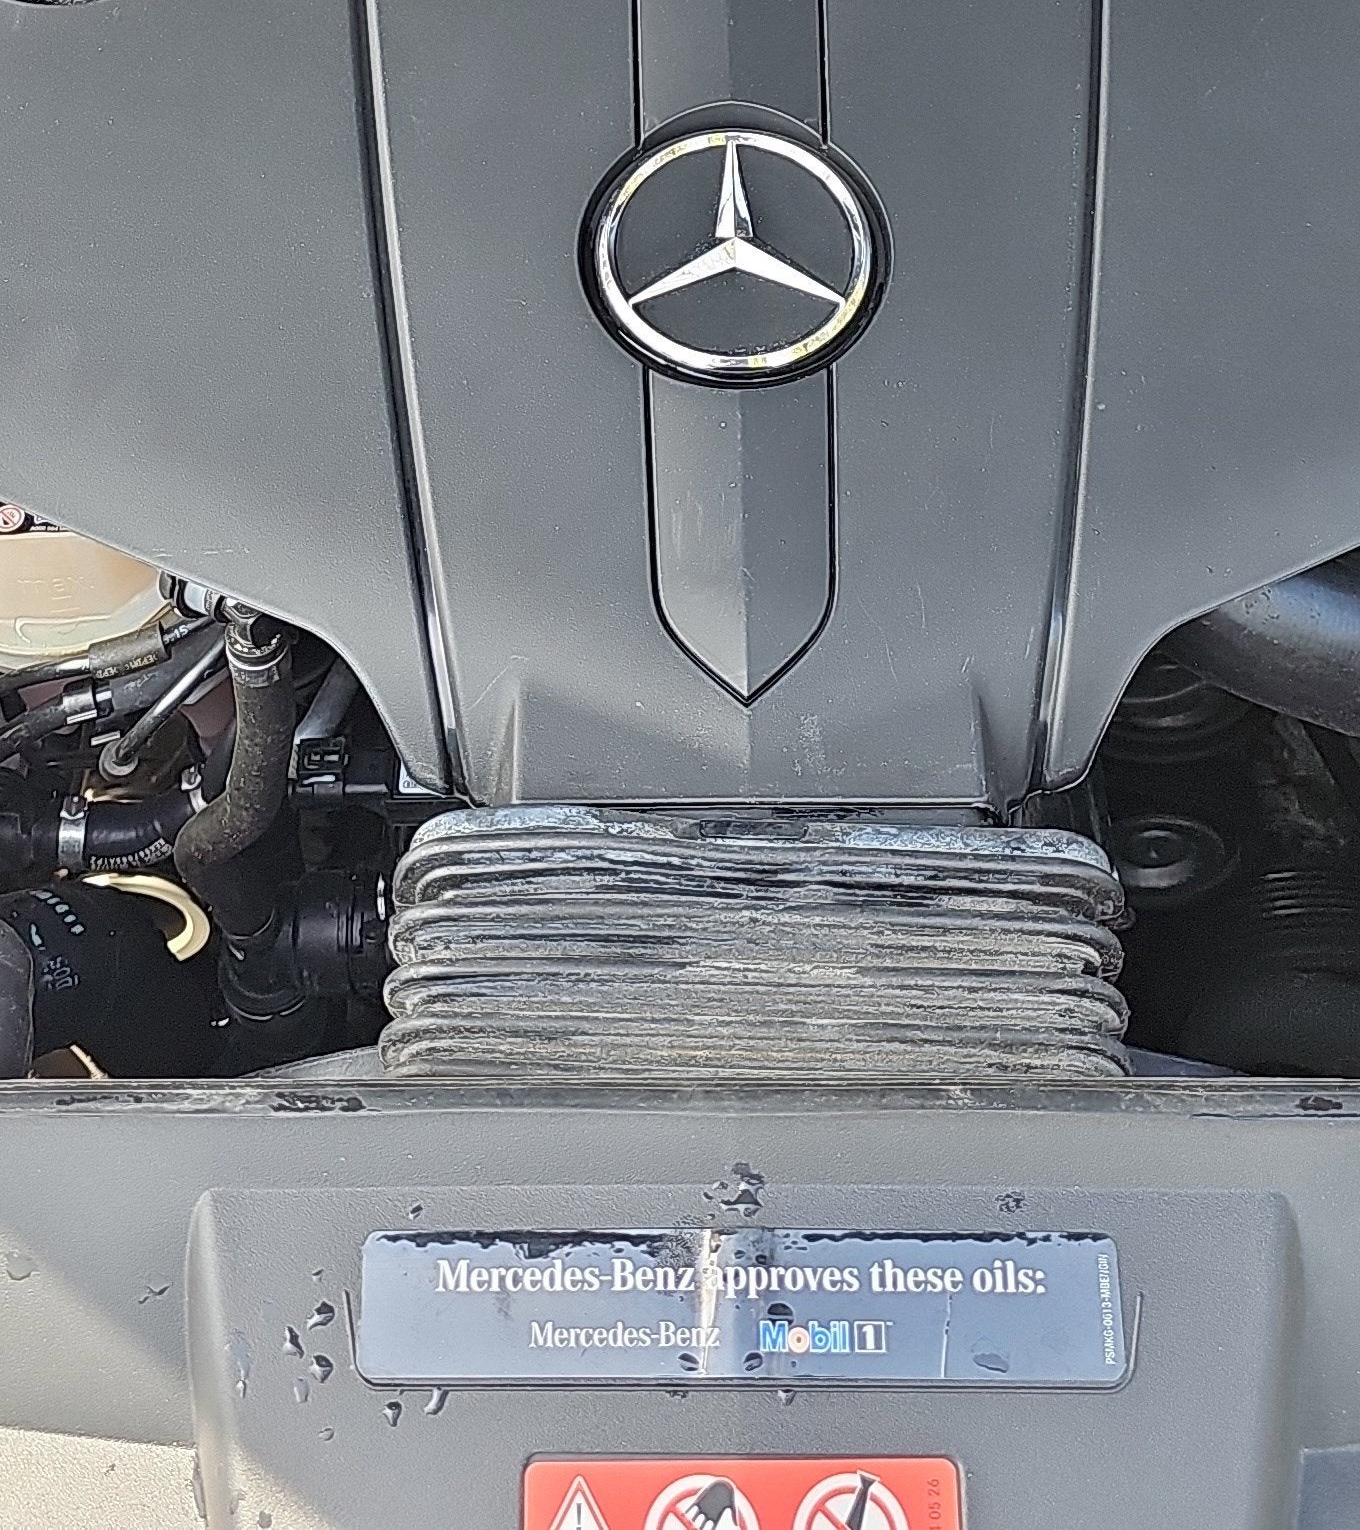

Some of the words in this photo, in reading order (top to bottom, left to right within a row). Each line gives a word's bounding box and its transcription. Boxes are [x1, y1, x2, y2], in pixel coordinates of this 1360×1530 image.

[436, 1258, 696, 1294] Mercedes-Benz
[704, 1264, 861, 1299] approves
[869, 1258, 964, 1293] these
[972, 1259, 1047, 1294] oils:
[529, 1319, 721, 1350] Mercedes-Benz
[760, 1320, 851, 1353] Mobil
[856, 1322, 883, 1352] 1
[926, 1478, 940, 1497] 26
[927, 1501, 942, 1520] 05
